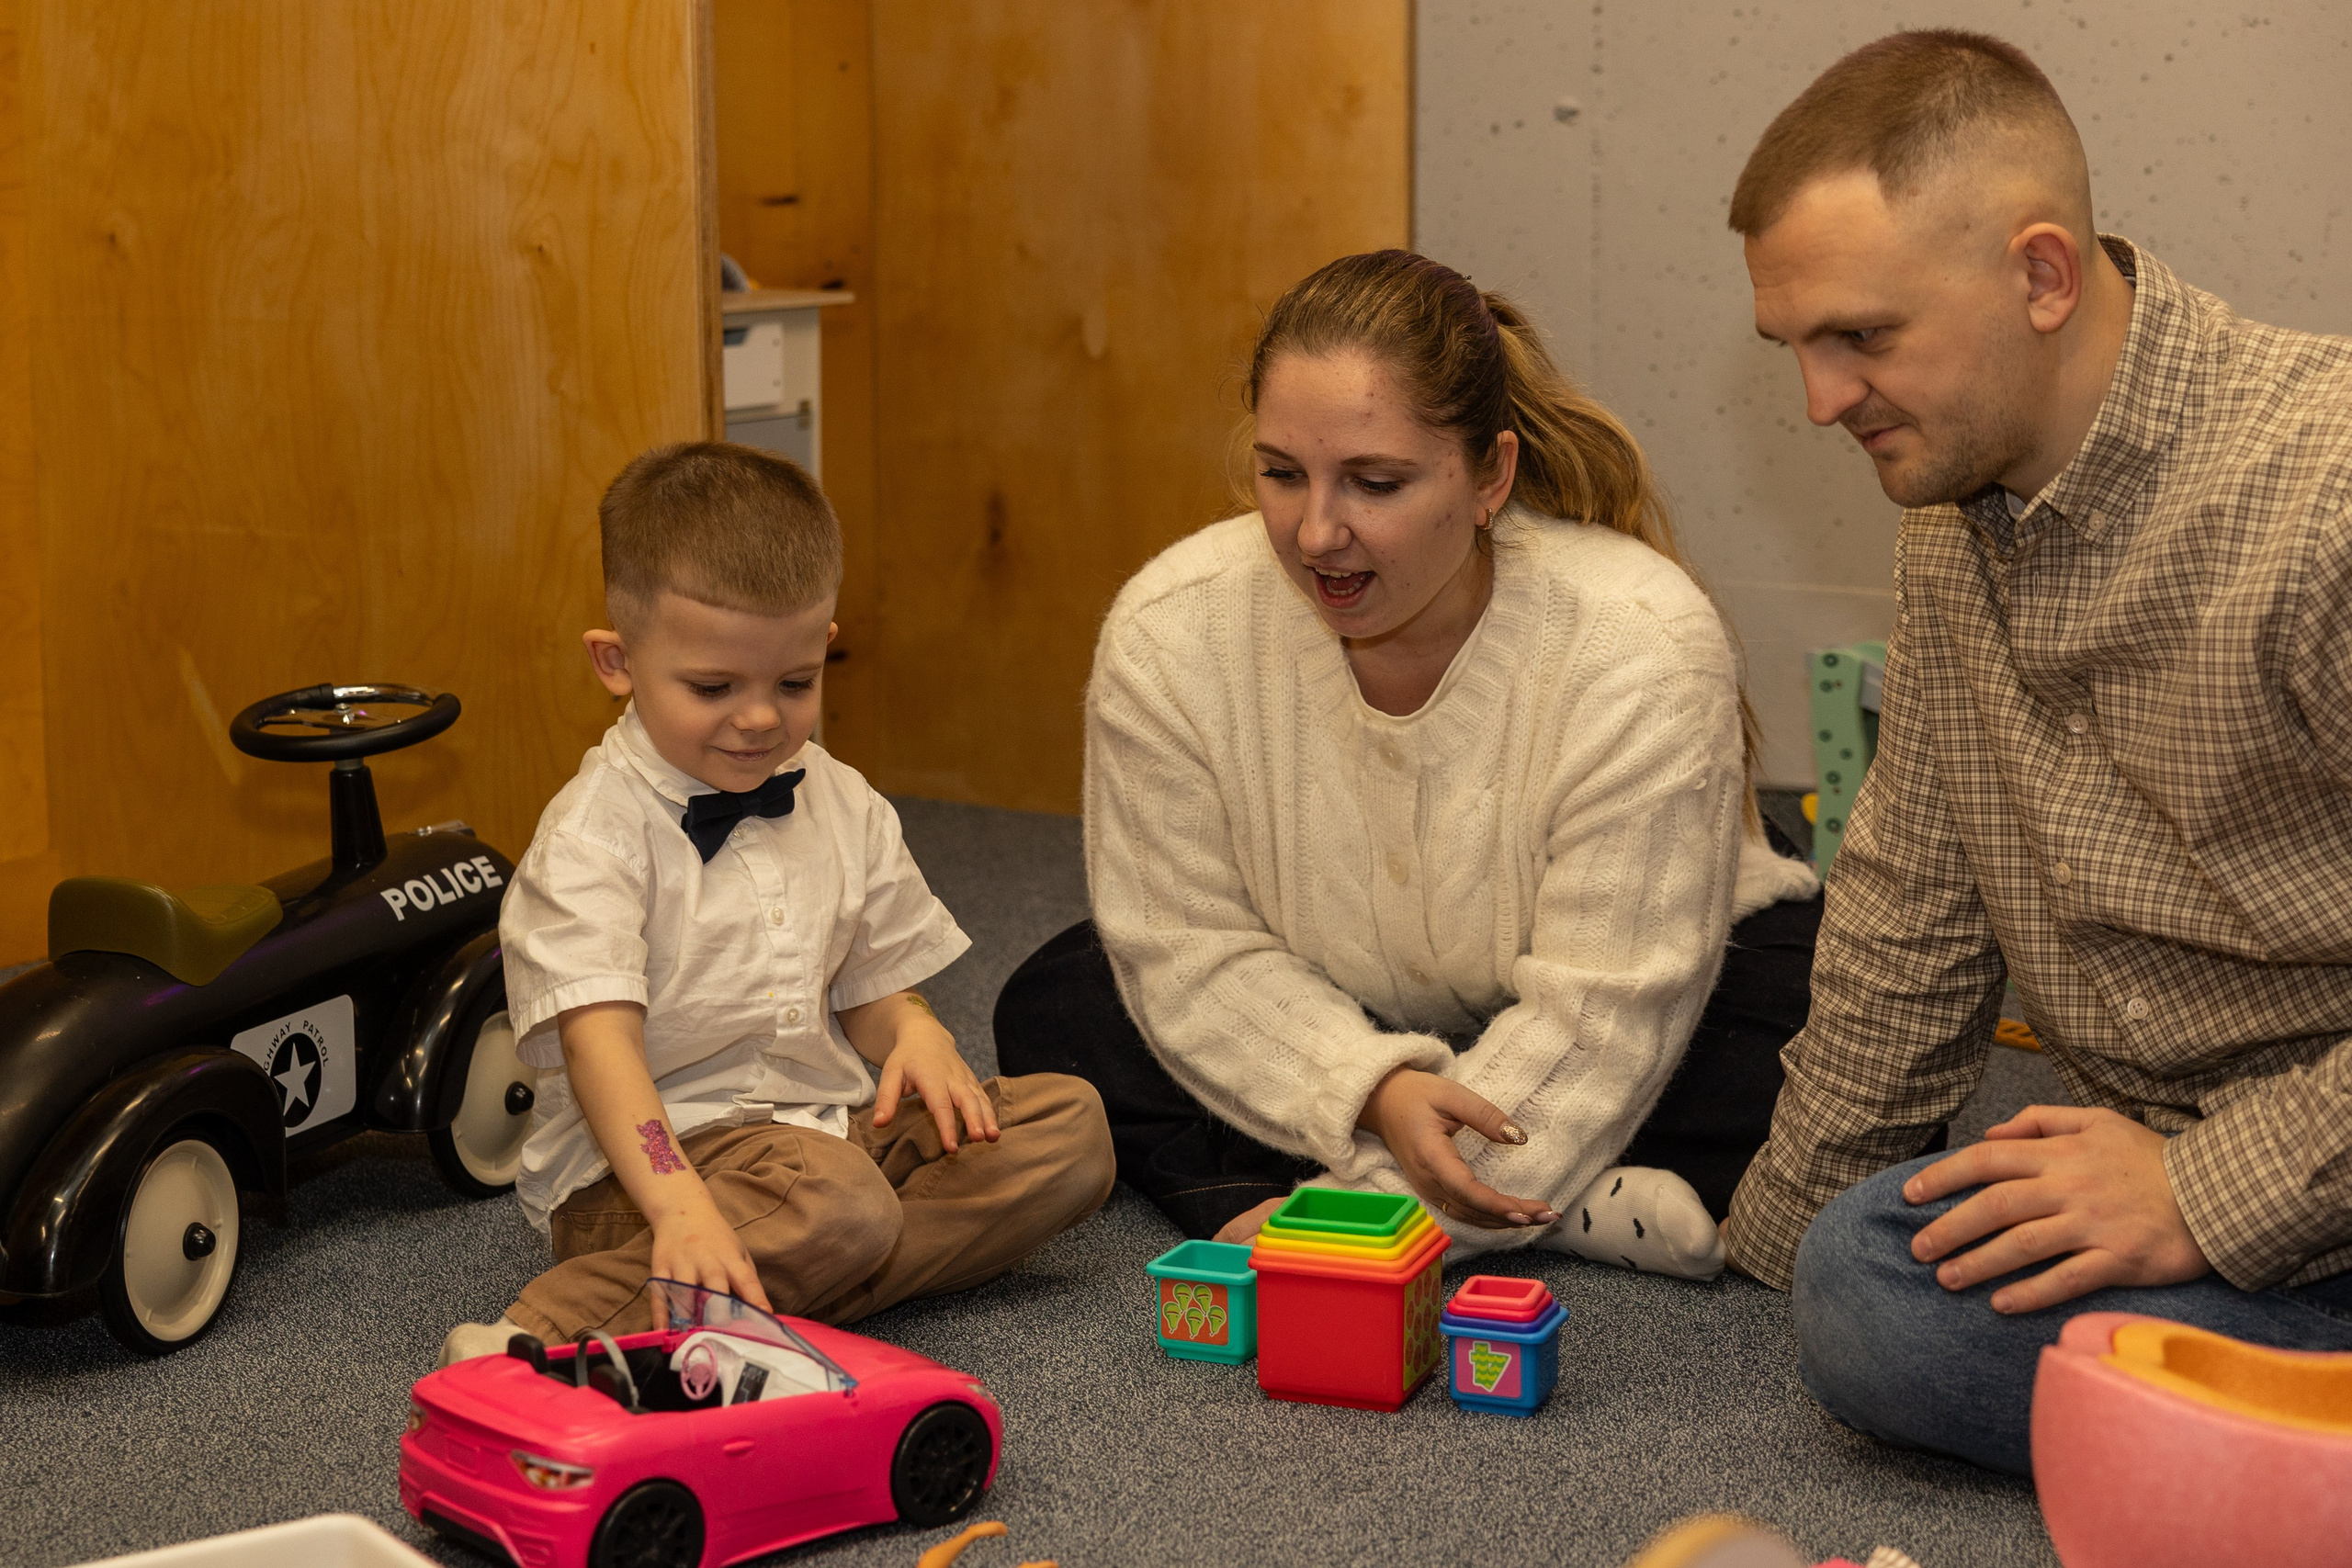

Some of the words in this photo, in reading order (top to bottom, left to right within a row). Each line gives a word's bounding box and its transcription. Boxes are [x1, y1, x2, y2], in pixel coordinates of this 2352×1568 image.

[380, 855, 503, 921] POLICE
[263, 1021, 291, 1071] GHWAY
[302, 1020, 329, 1067] PATROL
[1469, 1341, 1511, 1393] 4
